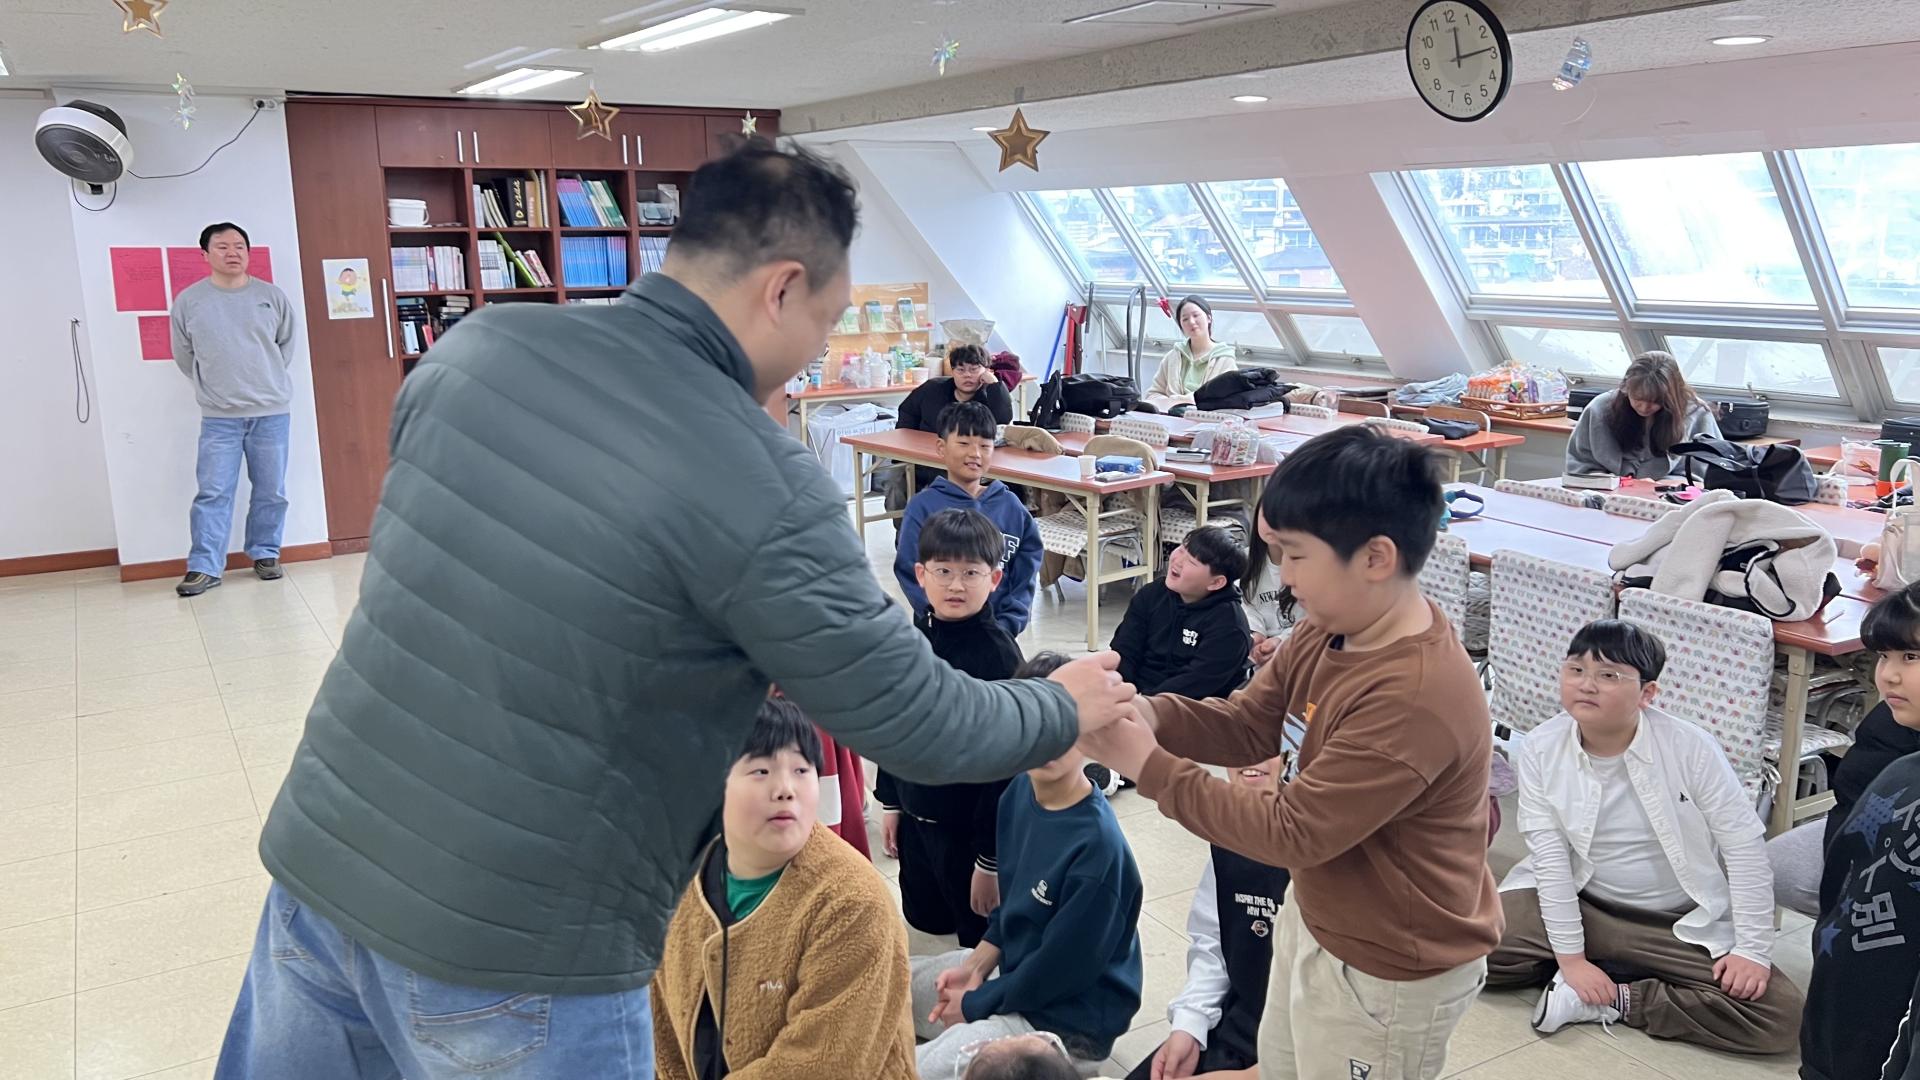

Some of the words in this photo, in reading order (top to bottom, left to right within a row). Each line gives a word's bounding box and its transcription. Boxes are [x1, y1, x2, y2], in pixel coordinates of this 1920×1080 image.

[1443, 9, 1456, 23] 12
[1464, 13, 1471, 26] 1
[1429, 19, 1440, 31] 11
[1479, 25, 1488, 39] 2
[1422, 35, 1434, 49] 10
[1490, 46, 1498, 59] 3
[1422, 58, 1431, 70] 9
[1489, 69, 1497, 82] 4
[1433, 78, 1441, 91] 8
[1480, 84, 1488, 97] 5
[1447, 90, 1455, 103] 7
[1464, 93, 1472, 105] 6
[758, 979, 784, 992] FILA
